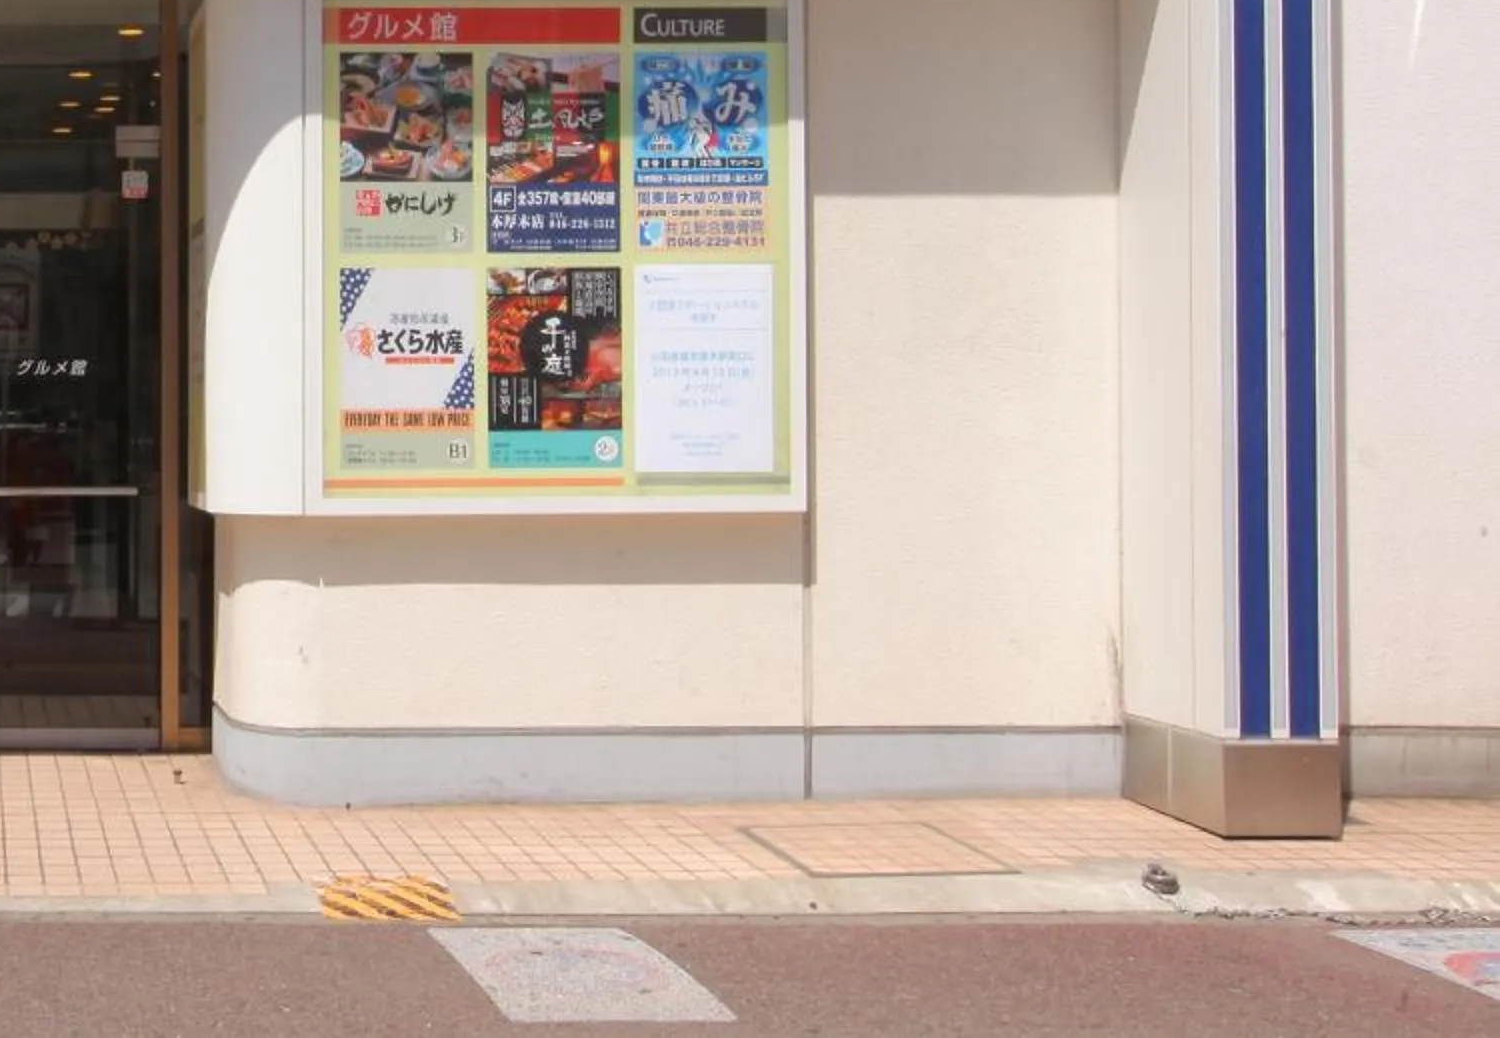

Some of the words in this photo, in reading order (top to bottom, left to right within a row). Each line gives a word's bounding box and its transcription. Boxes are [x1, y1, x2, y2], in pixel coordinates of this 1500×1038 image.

[348, 12, 457, 42] グルメ館
[641, 13, 725, 36] CULTURE
[493, 190, 513, 207] 4F
[377, 329, 464, 354] さくら水産
[16, 359, 87, 375] グルメ館
[385, 411, 399, 427] THE
[428, 411, 445, 427] LOW
[448, 411, 469, 427] PRICE
[449, 444, 467, 459] B1
